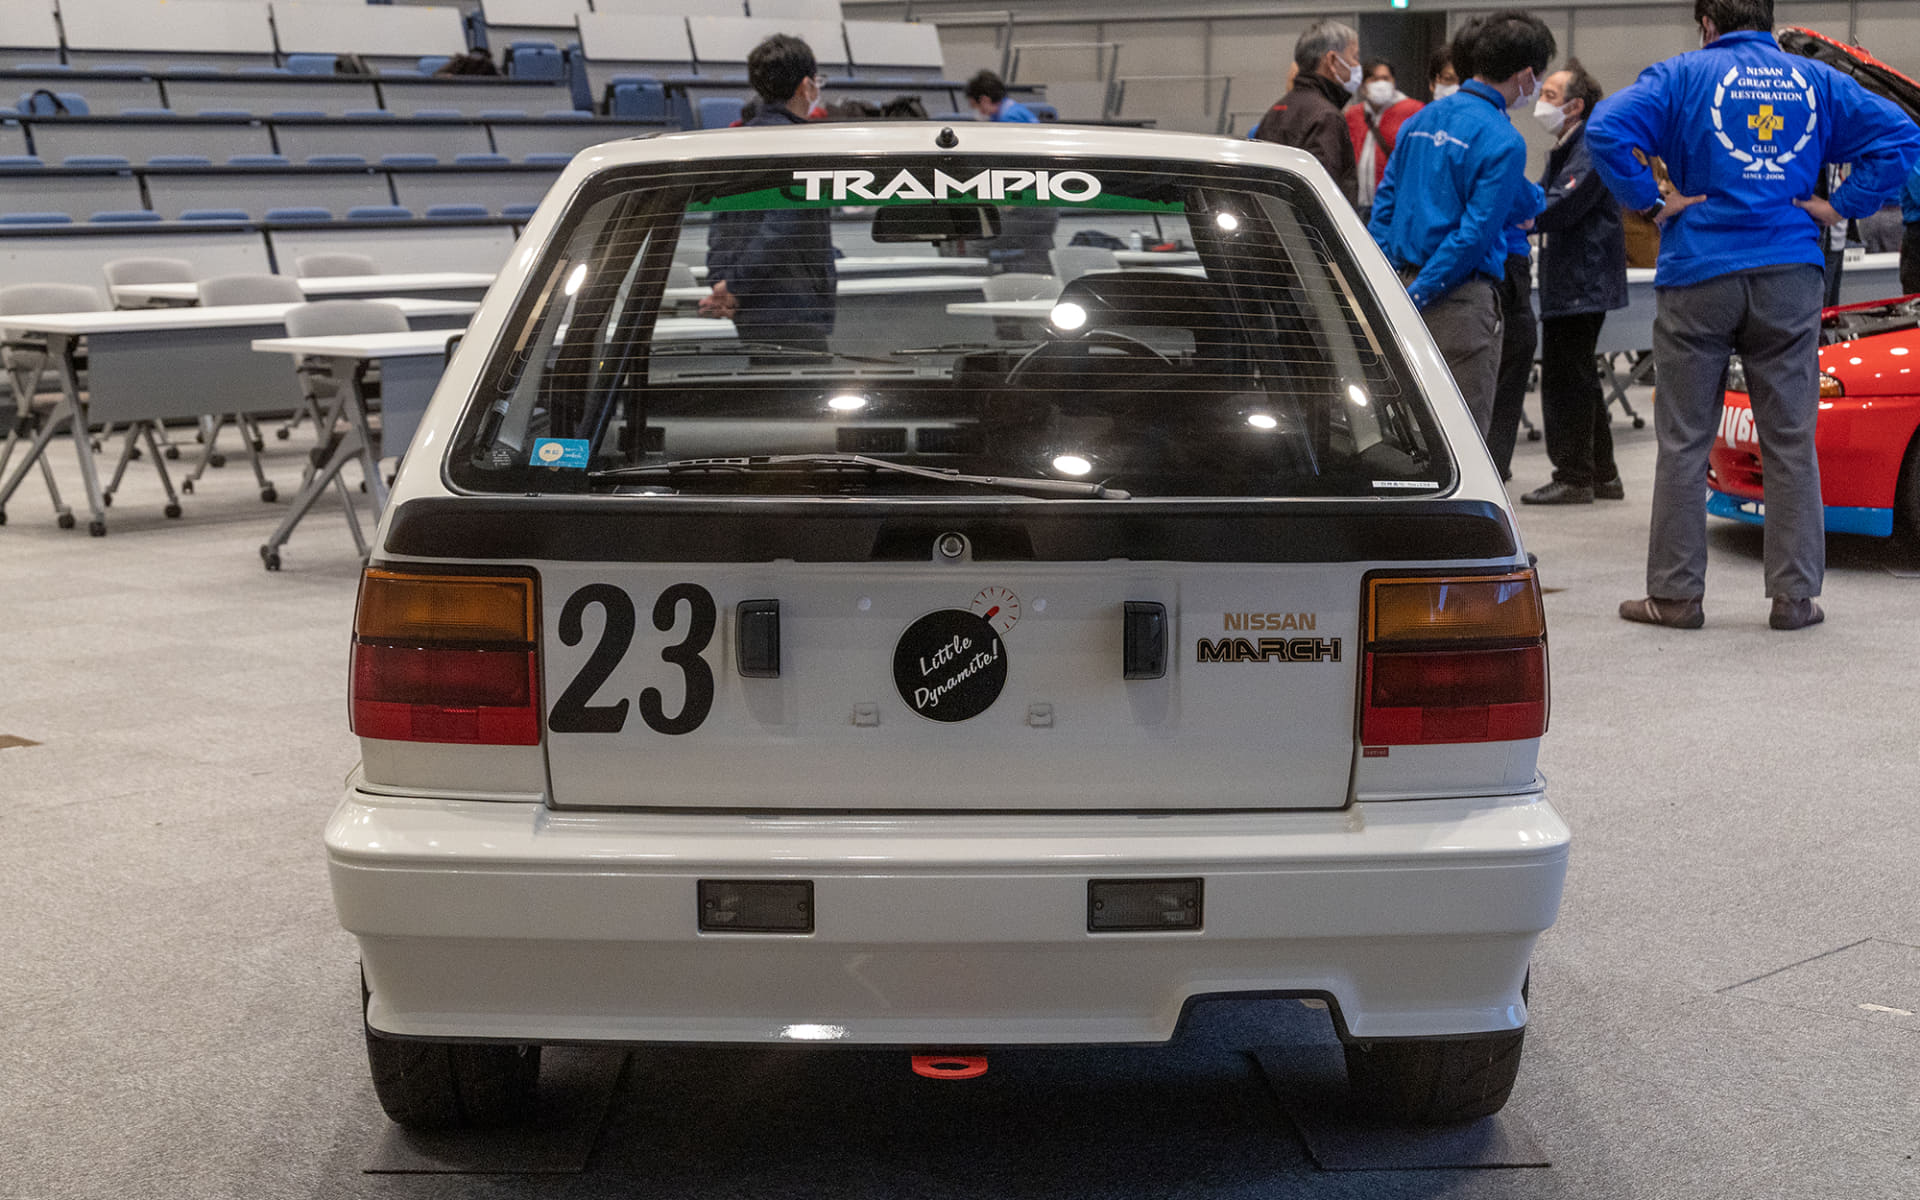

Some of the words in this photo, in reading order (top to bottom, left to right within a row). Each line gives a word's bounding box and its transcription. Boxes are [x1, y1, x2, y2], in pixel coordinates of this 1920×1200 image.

[1746, 66, 1783, 76] NISSAN
[1738, 78, 1771, 88] GREAT
[1773, 79, 1795, 89] CAR
[1730, 90, 1802, 101] RESTORATION
[1751, 144, 1778, 153] CLUB
[793, 168, 1102, 202] TRAMPIO
[1224, 613, 1316, 631] NISSAN
[548, 582, 717, 735] 23
[920, 634, 972, 676] Little
[1197, 637, 1342, 663] MARCH
[914, 638, 999, 709] Dynamite!
